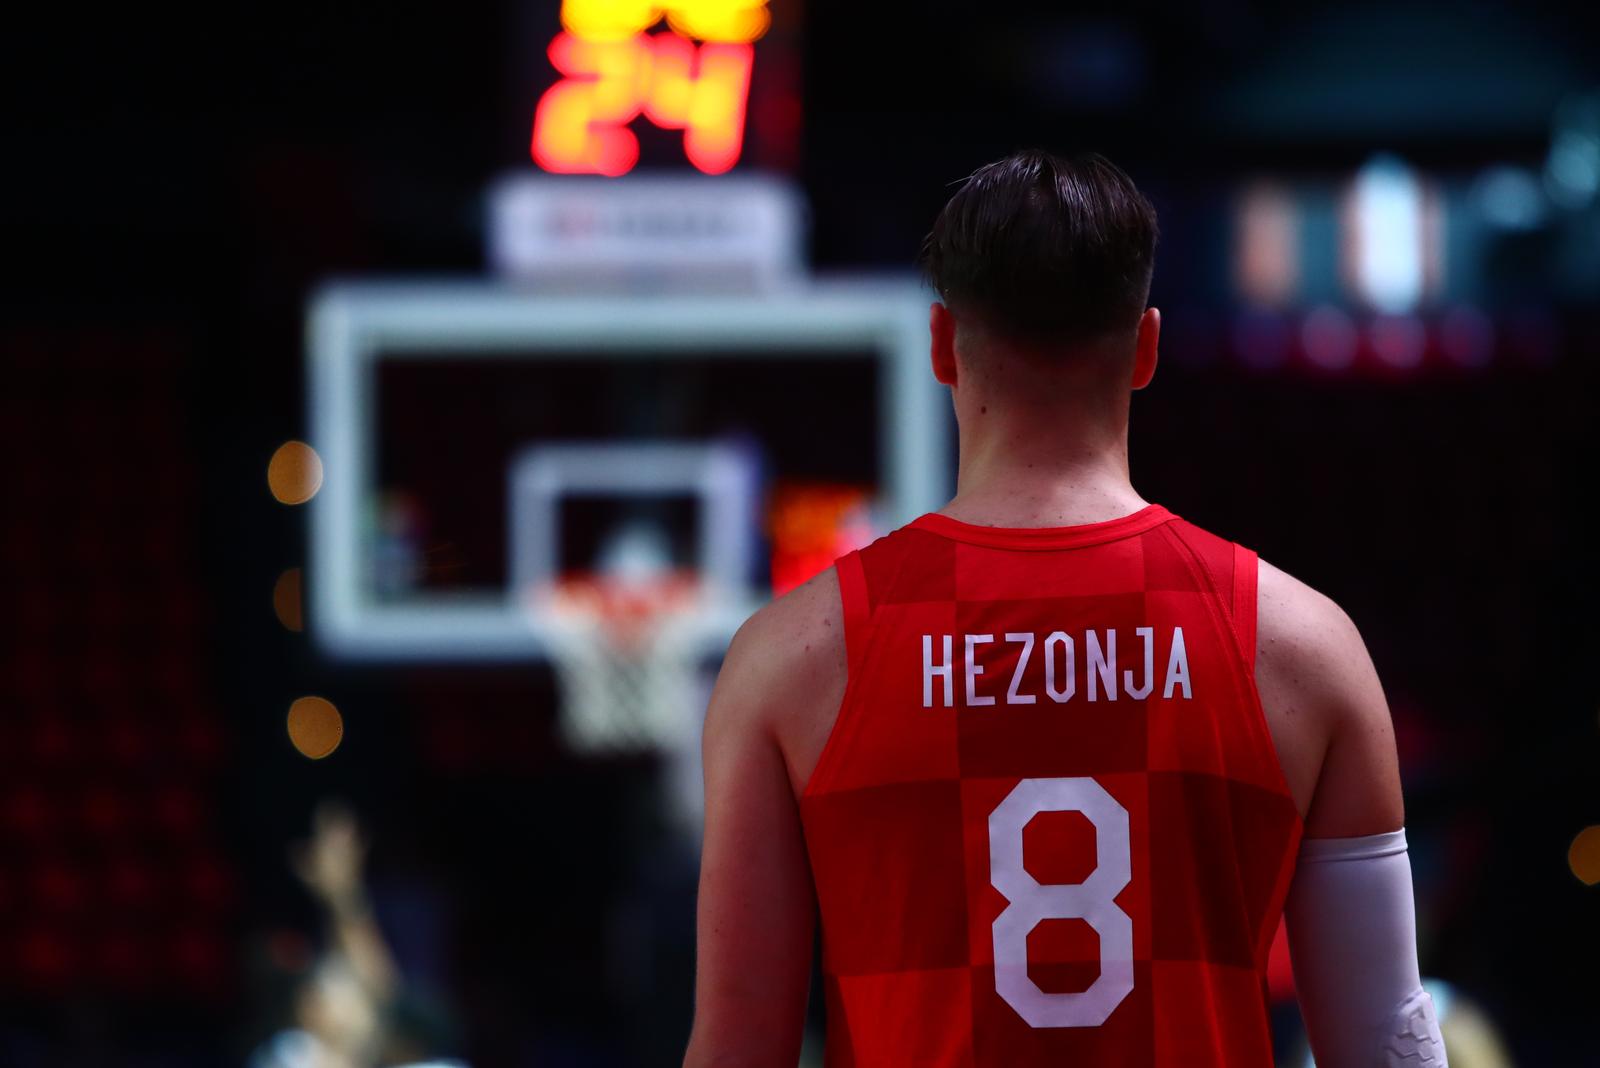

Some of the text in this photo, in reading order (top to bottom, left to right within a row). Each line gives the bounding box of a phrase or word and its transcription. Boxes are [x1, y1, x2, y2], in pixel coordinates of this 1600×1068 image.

[531, 31, 754, 177] 24
[922, 627, 1193, 707] HEZONJA
[988, 776, 1135, 1028] 8
